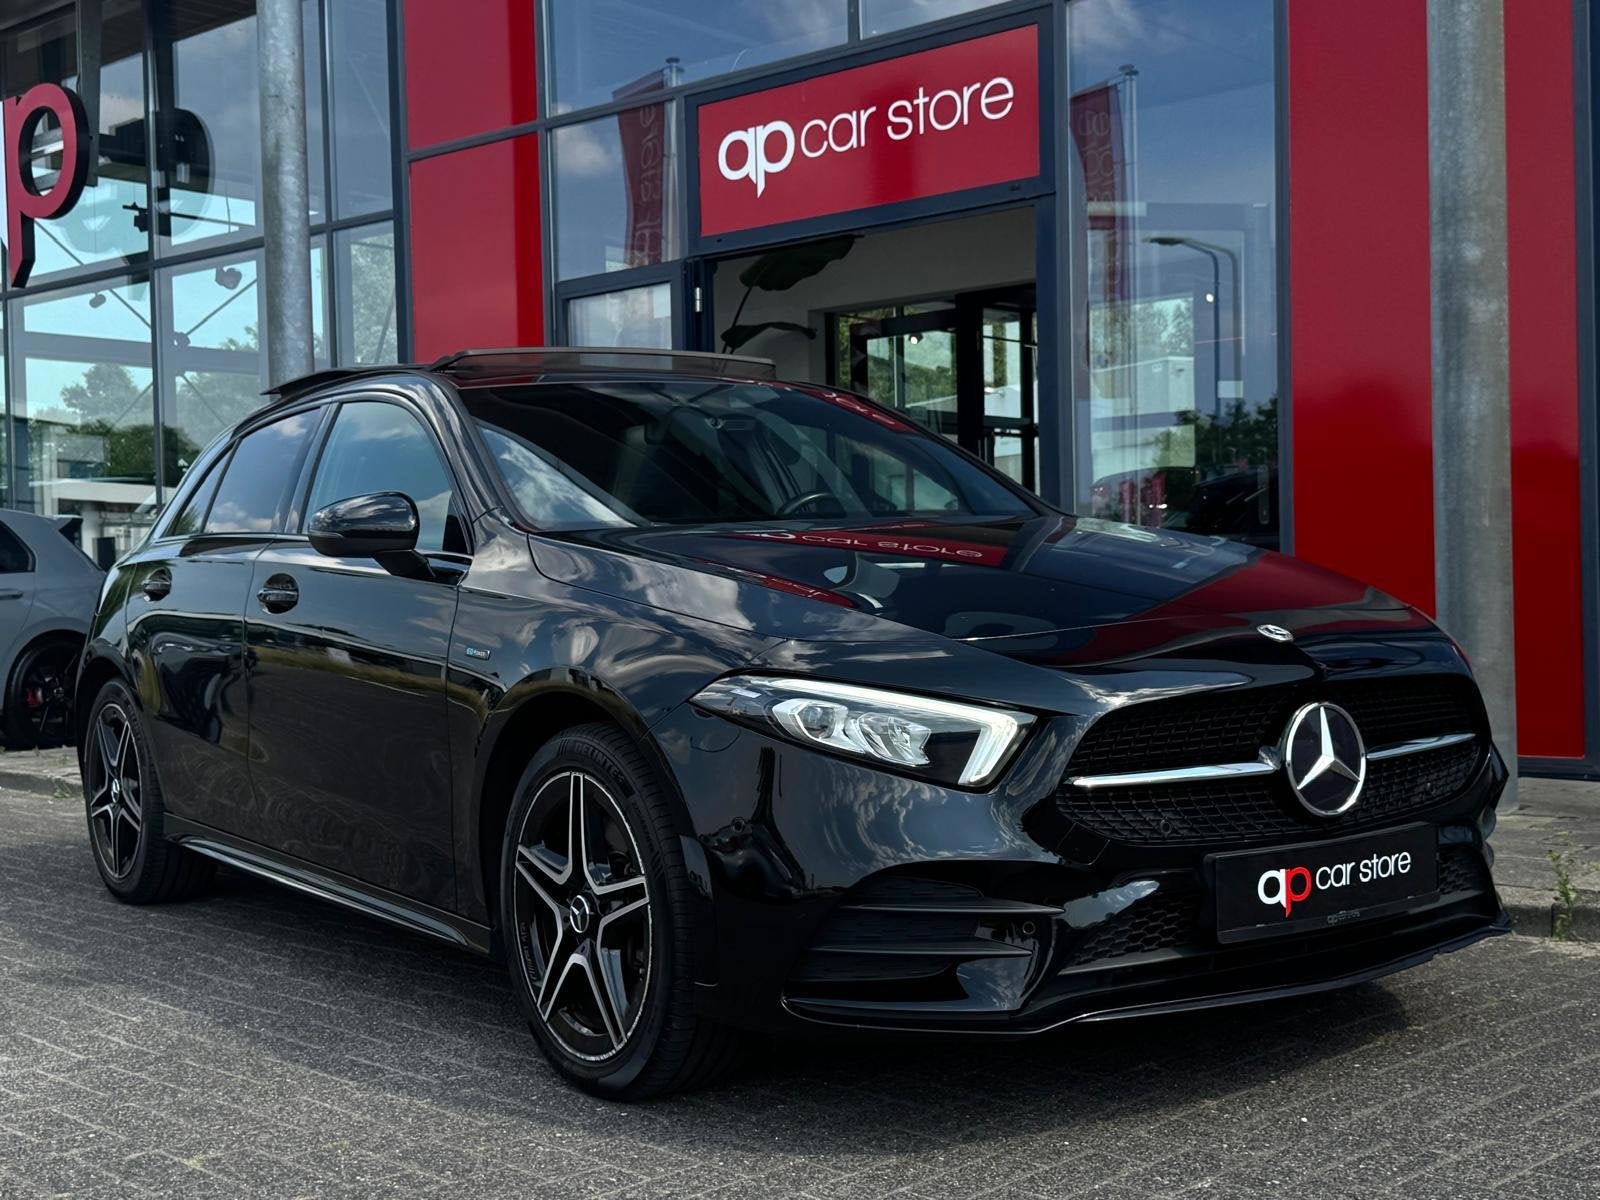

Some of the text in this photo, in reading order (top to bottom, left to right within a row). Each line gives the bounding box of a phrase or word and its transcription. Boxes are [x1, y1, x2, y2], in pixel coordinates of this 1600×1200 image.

[0, 83, 84, 287] p
[718, 77, 1014, 198] ap car store
[1257, 866, 1312, 918] ap
[1316, 861, 1355, 890] car
[1359, 851, 1412, 882] store
